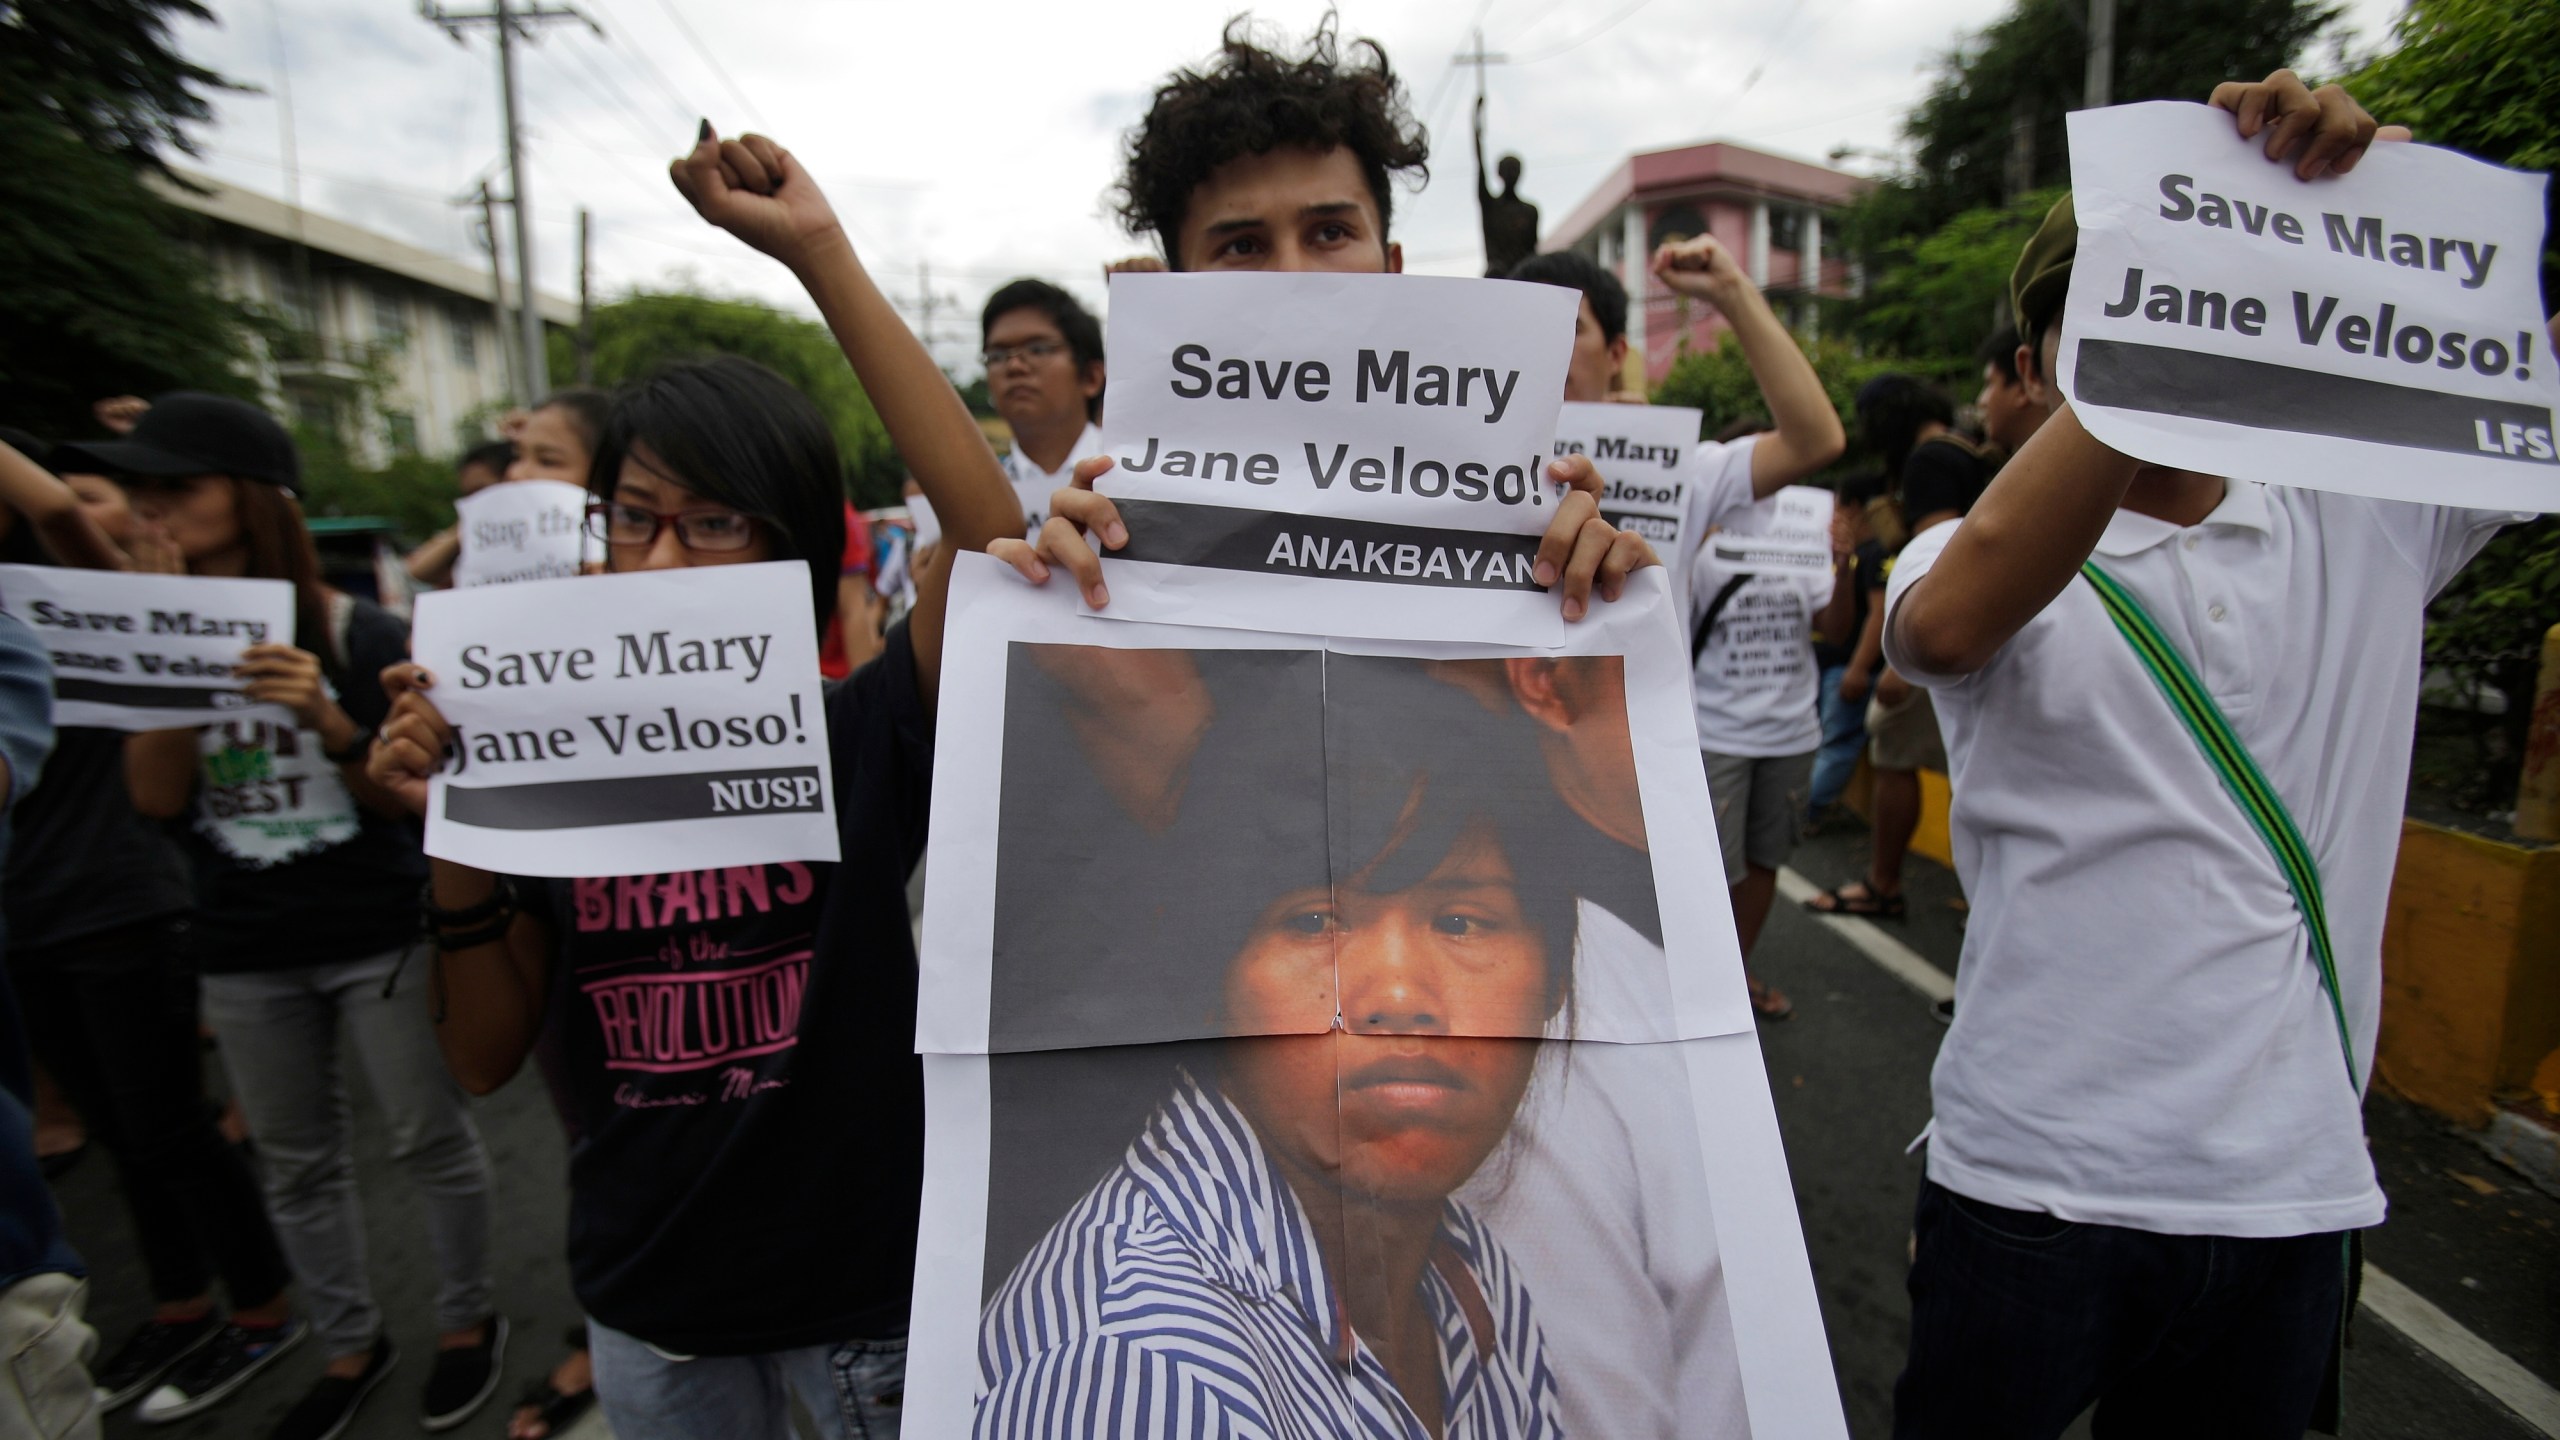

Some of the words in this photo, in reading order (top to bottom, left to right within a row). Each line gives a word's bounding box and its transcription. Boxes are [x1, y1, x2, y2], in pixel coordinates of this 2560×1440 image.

[2159, 173, 2304, 245] Save
[2321, 212, 2498, 290] Mary
[2104, 267, 2267, 337] Jane
[2291, 290, 2533, 382] Veloso!
[1170, 344, 1330, 402] Save
[1356, 349, 1520, 423] Mary
[1595, 437, 1679, 469] Mary
[2474, 419, 2553, 459] LFS
[1121, 438, 1280, 485] Jane
[1303, 442, 1542, 506] Veloso!
[1602, 480, 1682, 505] eloso!
[1266, 532, 1538, 583] ANAKBAYAN
[31, 600, 136, 633] Save
[148, 609, 268, 644] Mary
[52, 651, 124, 673] ane
[460, 645, 595, 689] Save
[615, 631, 772, 683] Mary
[453, 725, 577, 776] Jane
[588, 694, 807, 755] Veloso!
[212, 776, 311, 818] BEST
[708, 777, 819, 811] NUSP
[573, 860, 813, 932] BRAINS
[690, 931, 730, 962] the
[593, 962, 810, 1061] REVOLUTION
